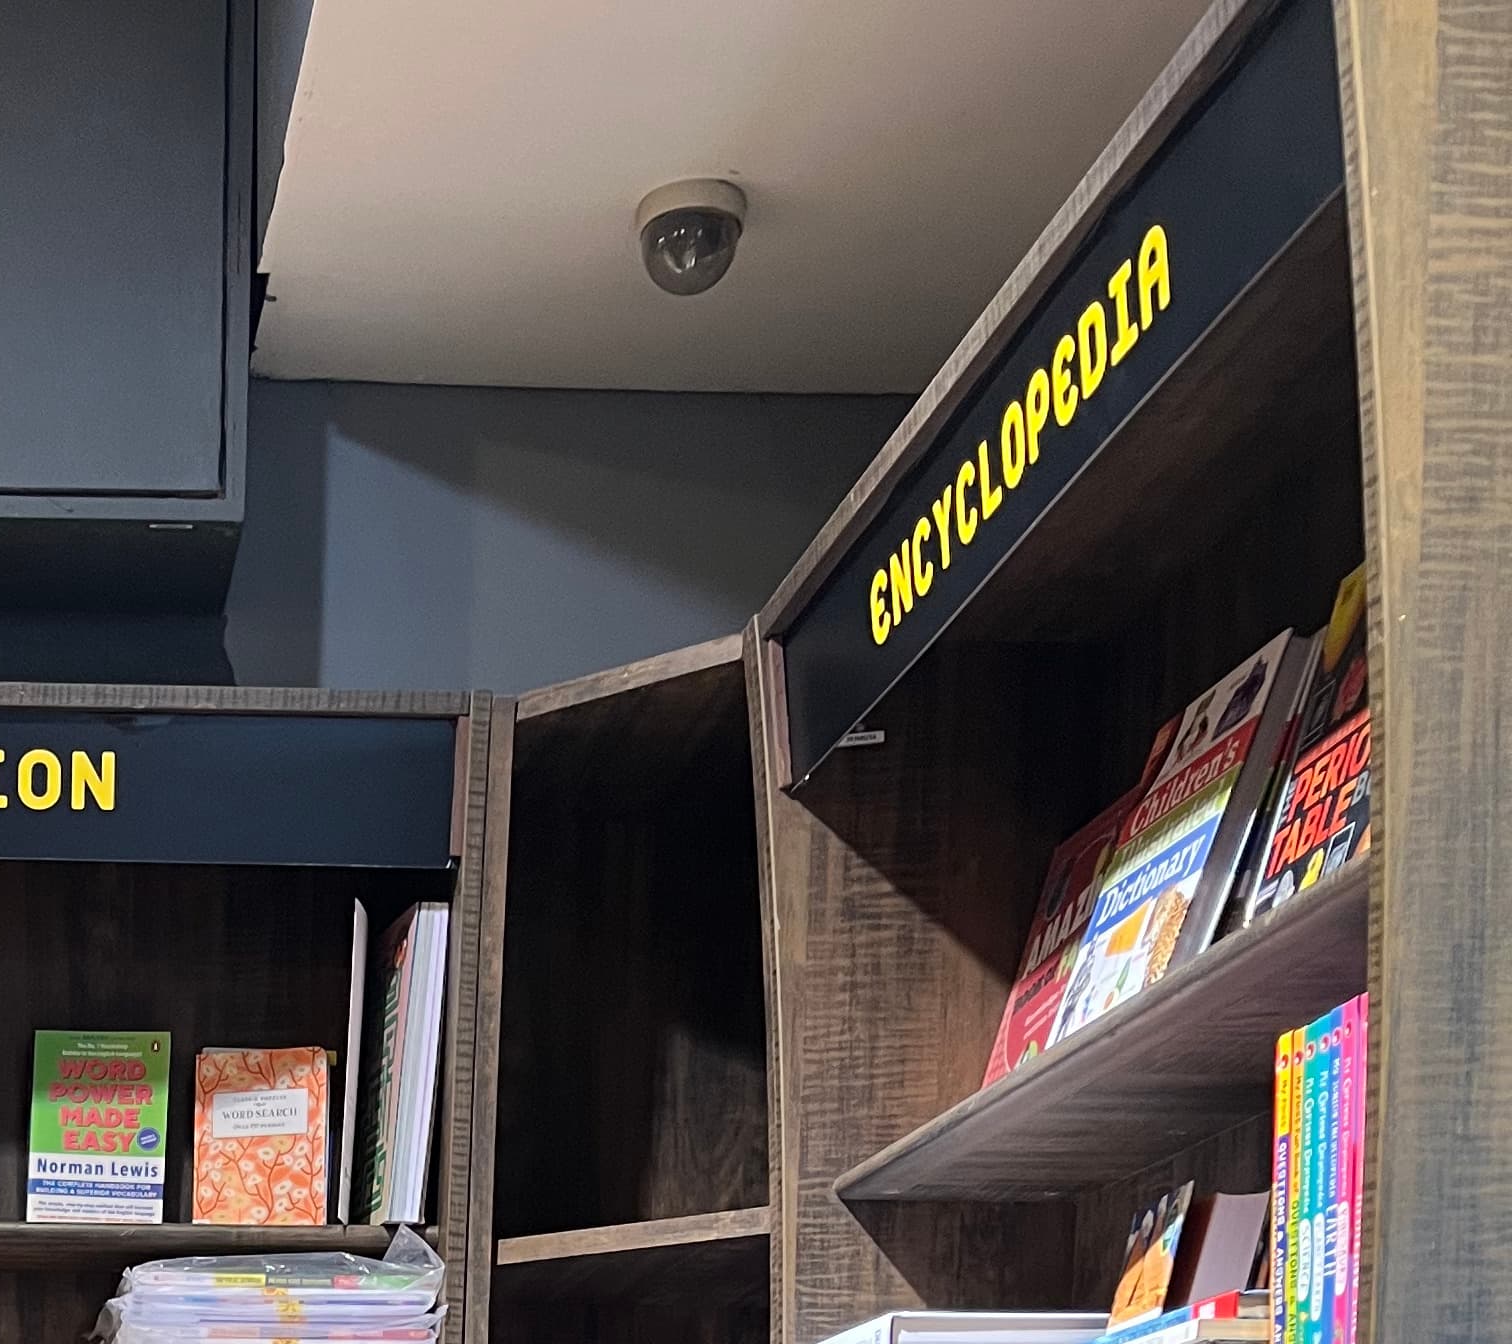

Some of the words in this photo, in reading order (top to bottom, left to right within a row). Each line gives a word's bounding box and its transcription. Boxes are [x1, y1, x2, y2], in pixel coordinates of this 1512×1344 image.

[870, 225, 1170, 645] ENCYCLOPEDIA
[1267, 777, 1357, 879] TABLE
[1096, 834, 1207, 928] Dictionary
[57, 1058, 147, 1082] WORD
[48, 1082, 154, 1106] POWER
[58, 1106, 141, 1129] MADE
[63, 1130, 139, 1153] EASY
[37, 1158, 104, 1176] Norman
[110, 1160, 159, 1178] Lewis
